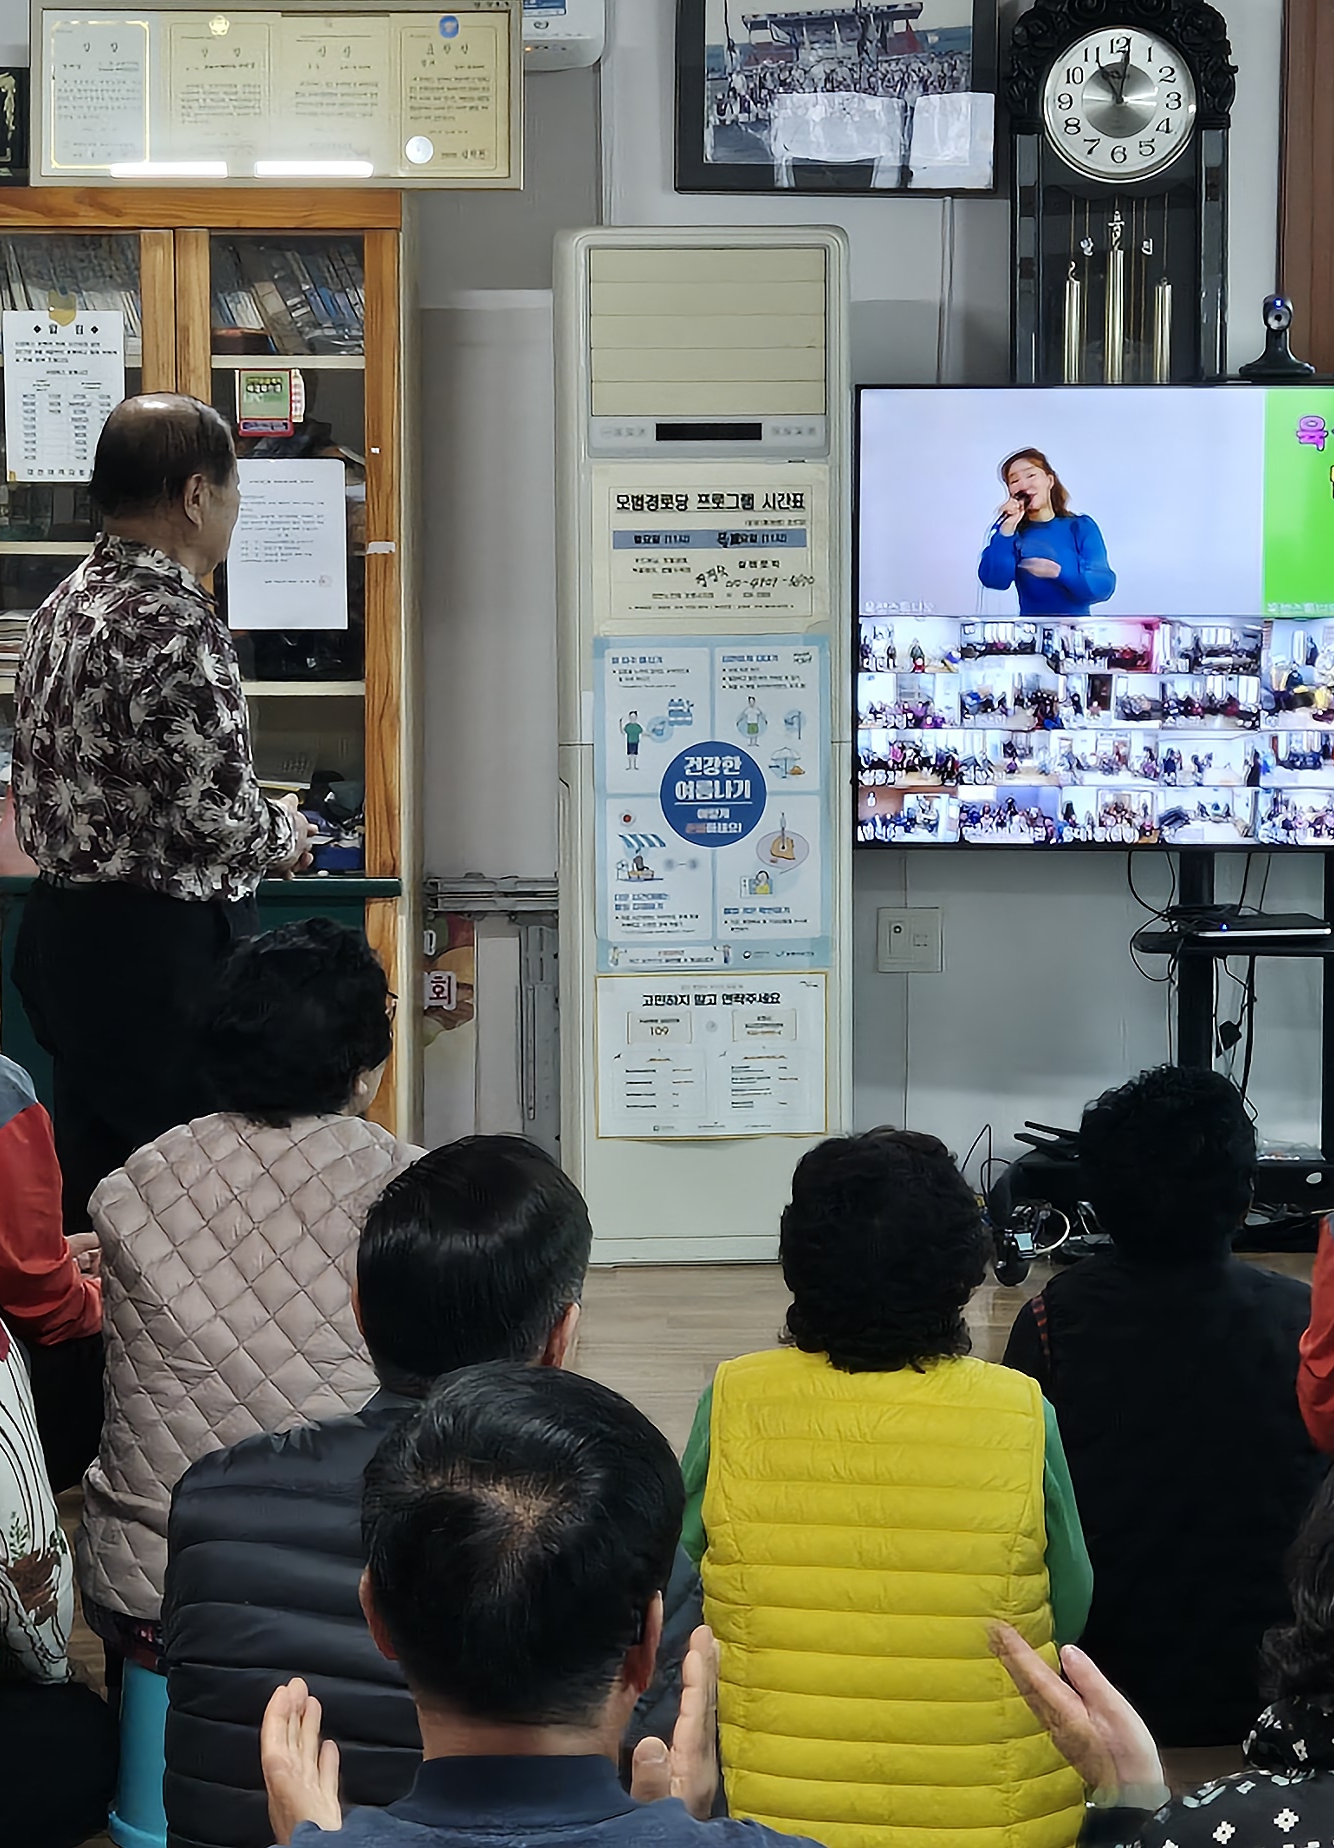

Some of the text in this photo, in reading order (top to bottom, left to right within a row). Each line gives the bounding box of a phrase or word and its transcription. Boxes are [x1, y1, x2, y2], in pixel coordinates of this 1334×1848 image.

[1109, 37, 1132, 55] 12
[1147, 47, 1153, 63] 1
[1065, 66, 1085, 85] 10
[1158, 65, 1178, 83] 2
[1058, 93, 1074, 110] 9
[1165, 92, 1183, 110] 3
[1064, 118, 1081, 135] 8
[1155, 117, 1172, 134] 4
[1083, 139, 1101, 156] 7
[1110, 146, 1127, 164] 6
[1139, 139, 1155, 157] 5
[616, 492, 805, 512] 모범경로당 프로그램 시간표
[684, 755, 743, 777] 건강한
[674, 779, 751, 801] 여름나기
[642, 994, 691, 1007] 고민하지
[721, 992, 782, 1006] 연락주세요
[649, 1026, 669, 1036] 109
